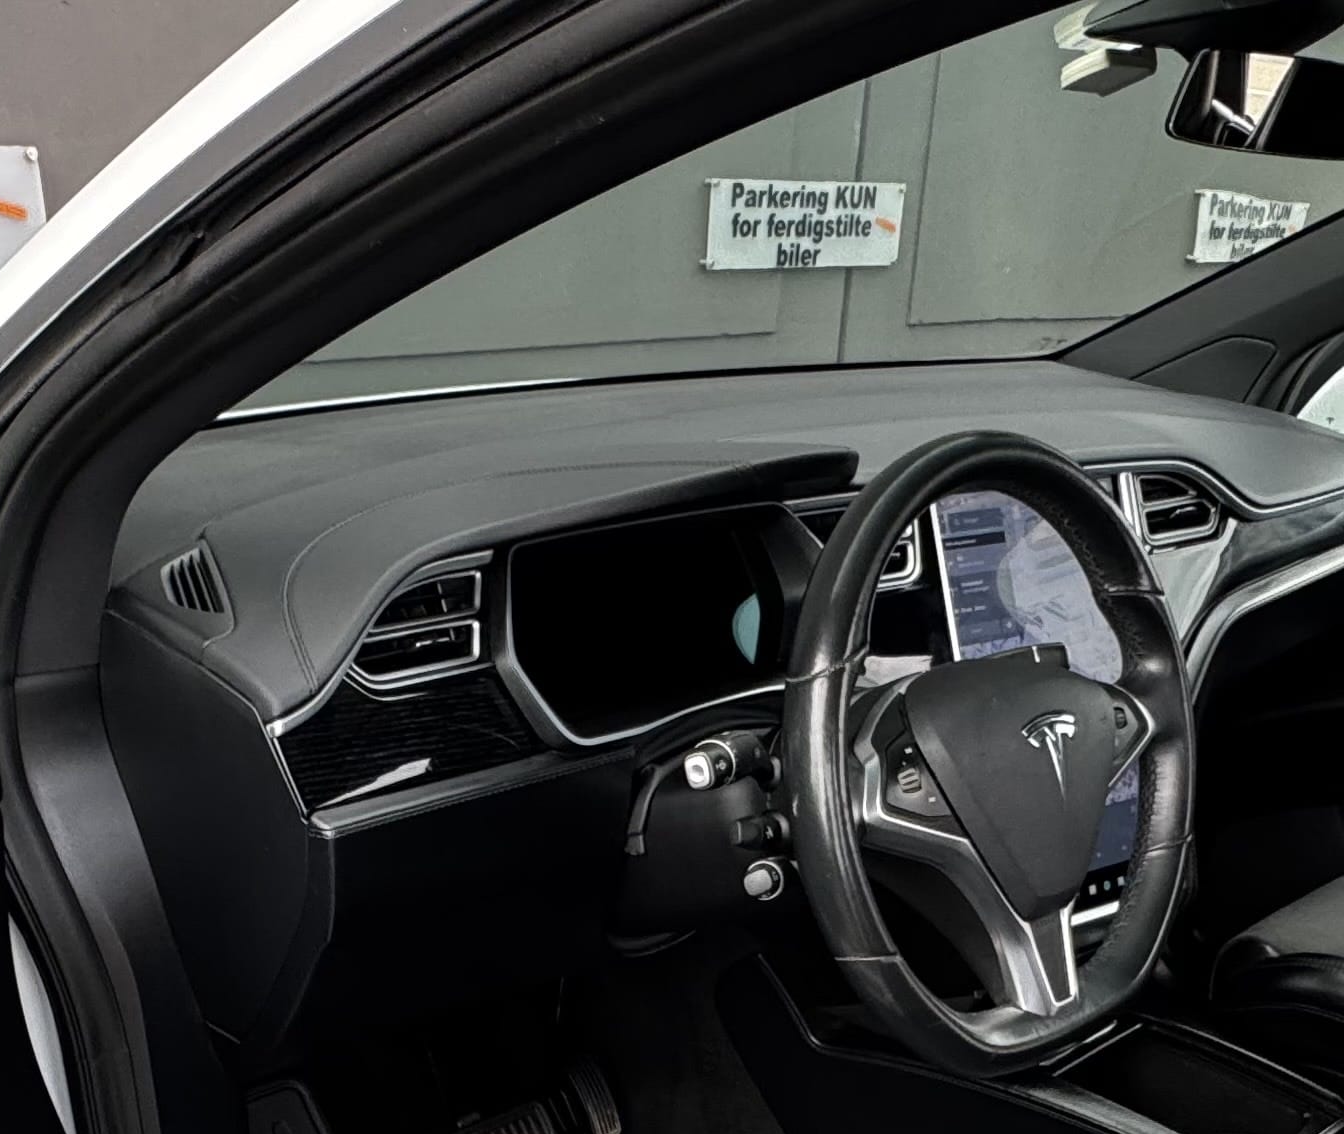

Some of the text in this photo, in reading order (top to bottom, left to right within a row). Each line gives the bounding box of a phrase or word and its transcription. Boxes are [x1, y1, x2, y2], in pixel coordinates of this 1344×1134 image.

[731, 182, 877, 215] Parkering KUN
[1209, 193, 1266, 226] Parkering
[731, 212, 872, 244] for ferdigstilte
[776, 243, 822, 268] biler
